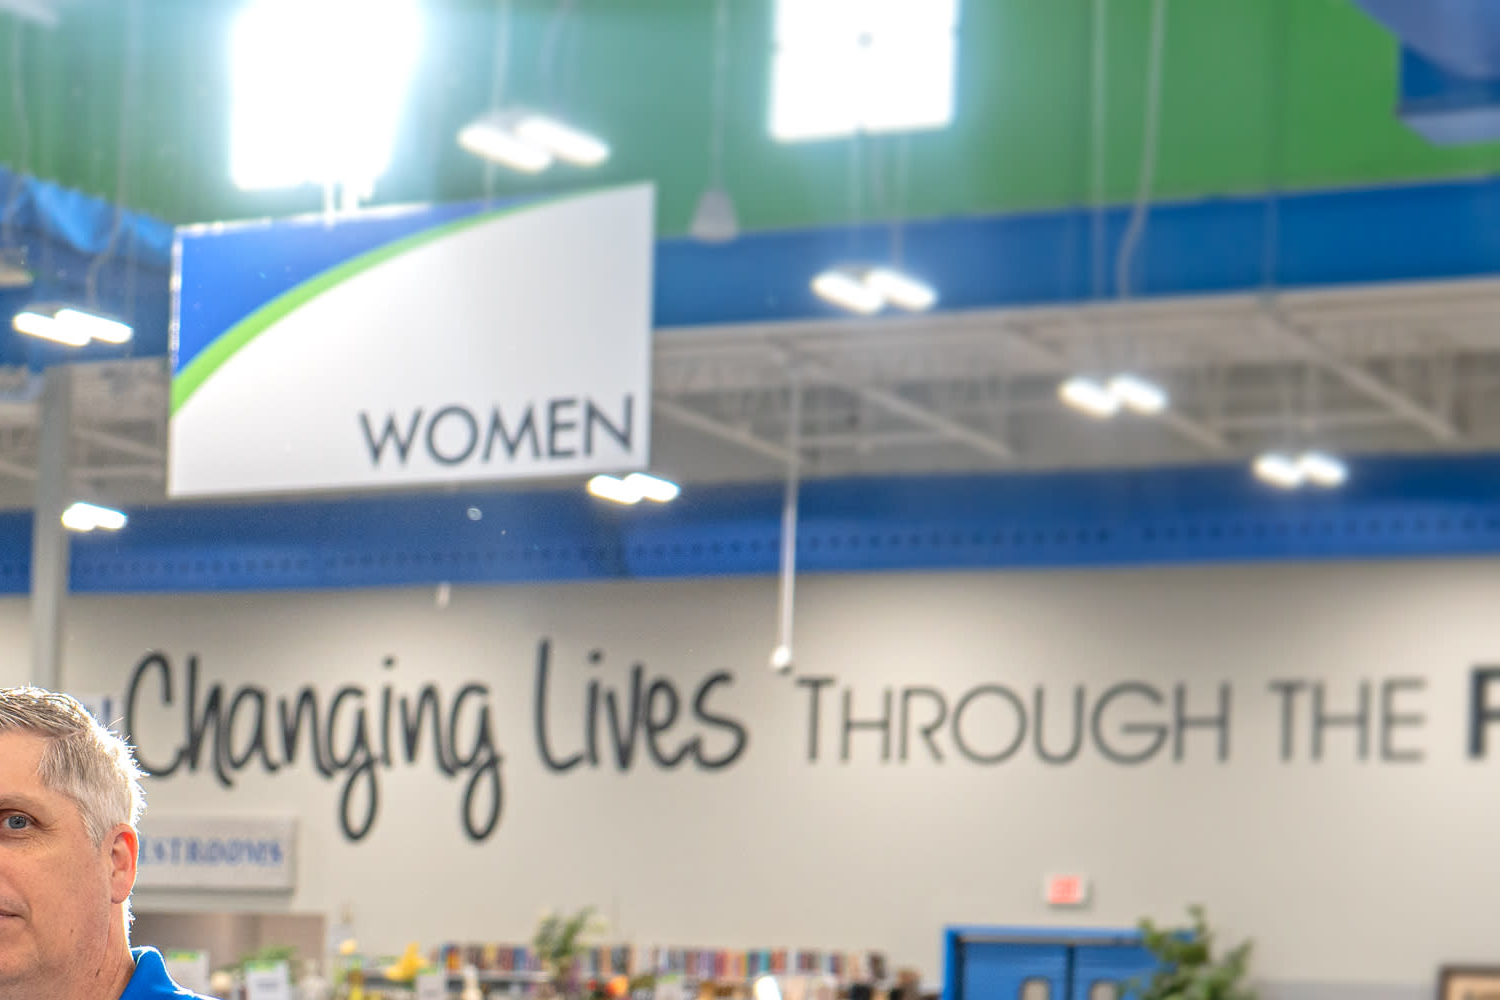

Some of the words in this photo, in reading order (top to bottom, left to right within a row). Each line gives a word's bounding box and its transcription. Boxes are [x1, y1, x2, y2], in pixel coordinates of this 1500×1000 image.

[358, 392, 634, 468] WOMEN
[125, 650, 505, 842] Changing
[533, 637, 749, 772] Lives
[797, 676, 1232, 766] THROUGH
[1268, 678, 1427, 763] THE
[138, 837, 283, 865] ESTROOMS
